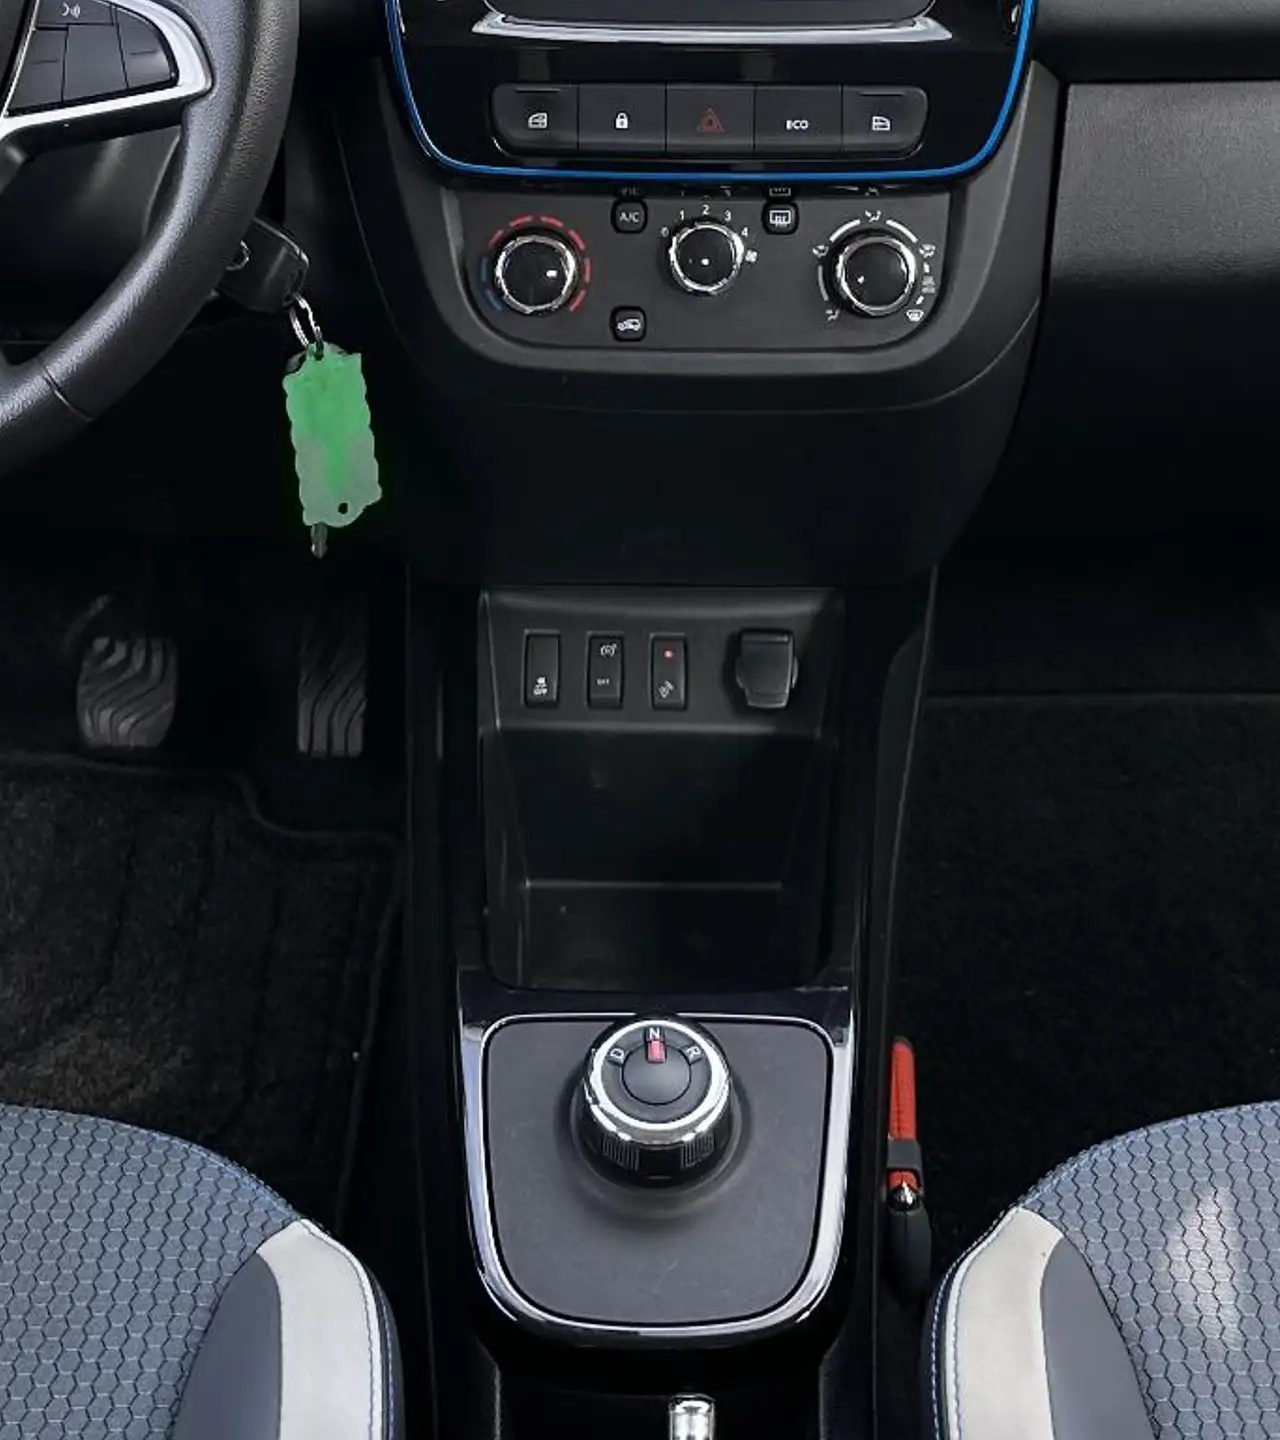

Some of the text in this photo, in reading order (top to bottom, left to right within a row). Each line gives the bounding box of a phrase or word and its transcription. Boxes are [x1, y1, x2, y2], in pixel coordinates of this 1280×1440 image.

[786, 120, 810, 131] ECO
[619, 211, 640, 223] A/C
[702, 203, 711, 215] 2
[724, 209, 732, 221] 3
[741, 226, 749, 237] 4
[609, 1026, 701, 1059] D N R
